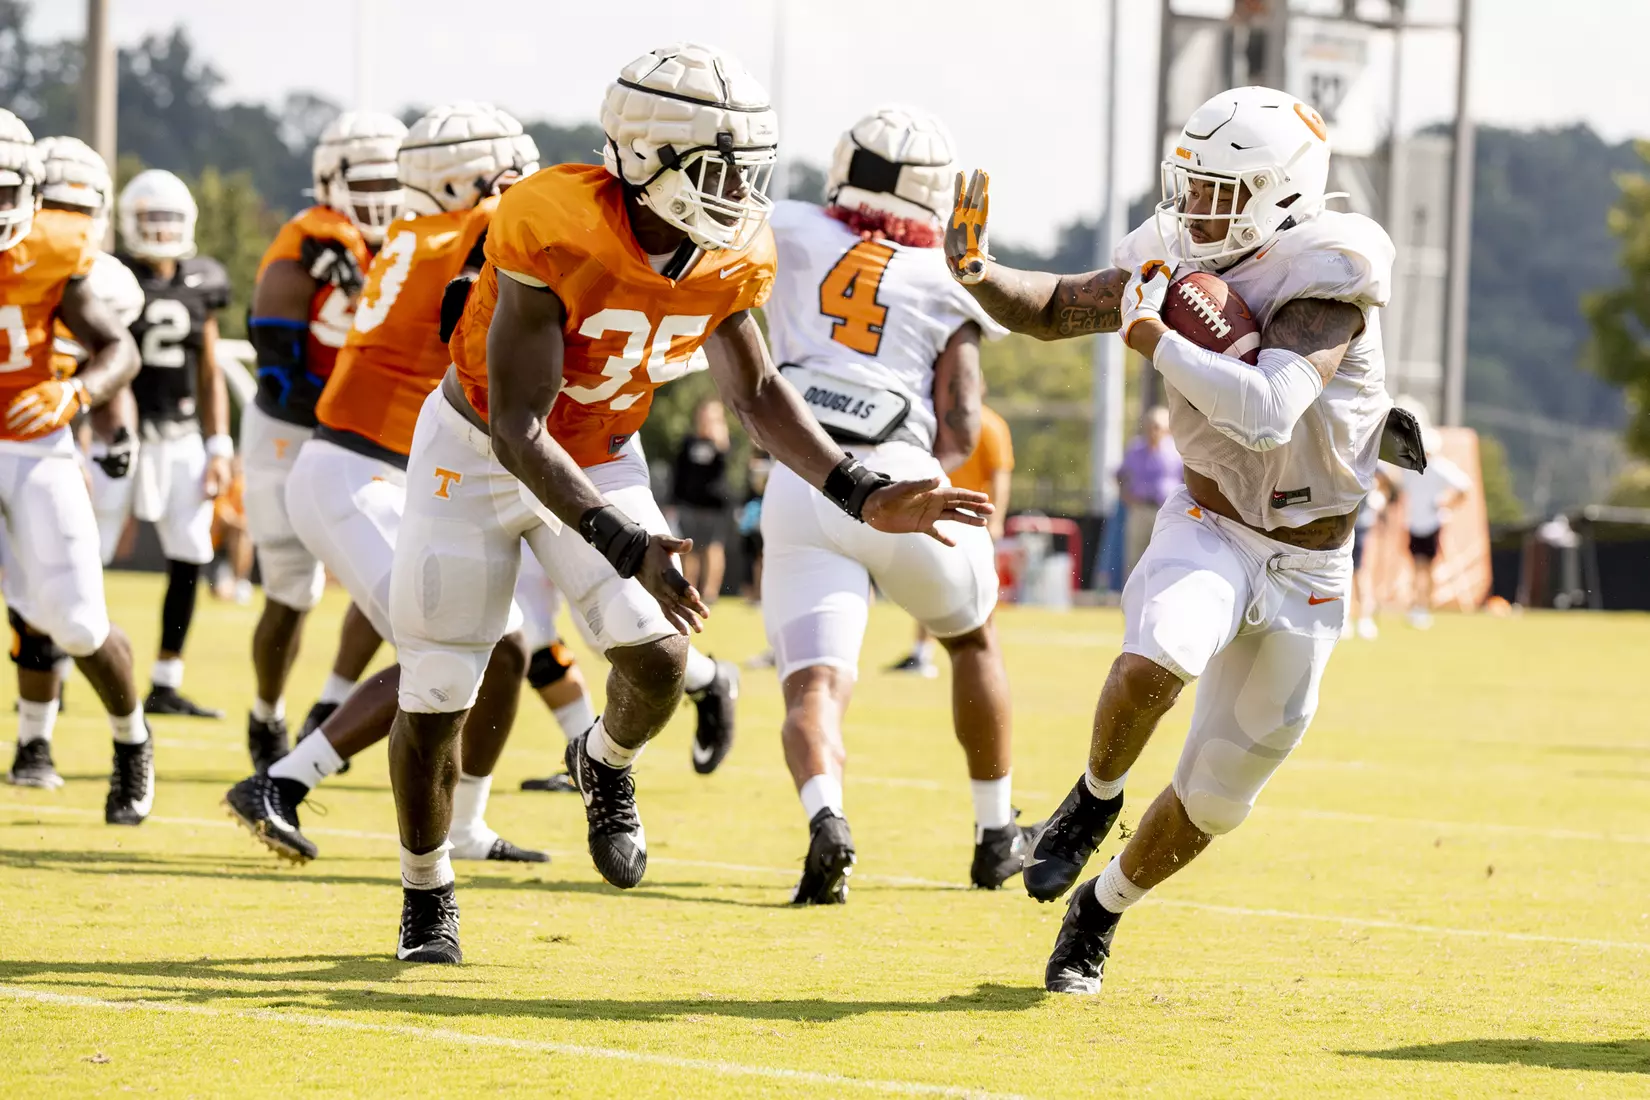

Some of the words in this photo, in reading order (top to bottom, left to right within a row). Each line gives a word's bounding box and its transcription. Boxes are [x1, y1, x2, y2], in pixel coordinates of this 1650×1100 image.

[819, 240, 897, 357] 4
[141, 299, 191, 369] 2
[561, 308, 710, 411] 35
[804, 386, 875, 419] DOUGLAS
[434, 467, 462, 499] T
